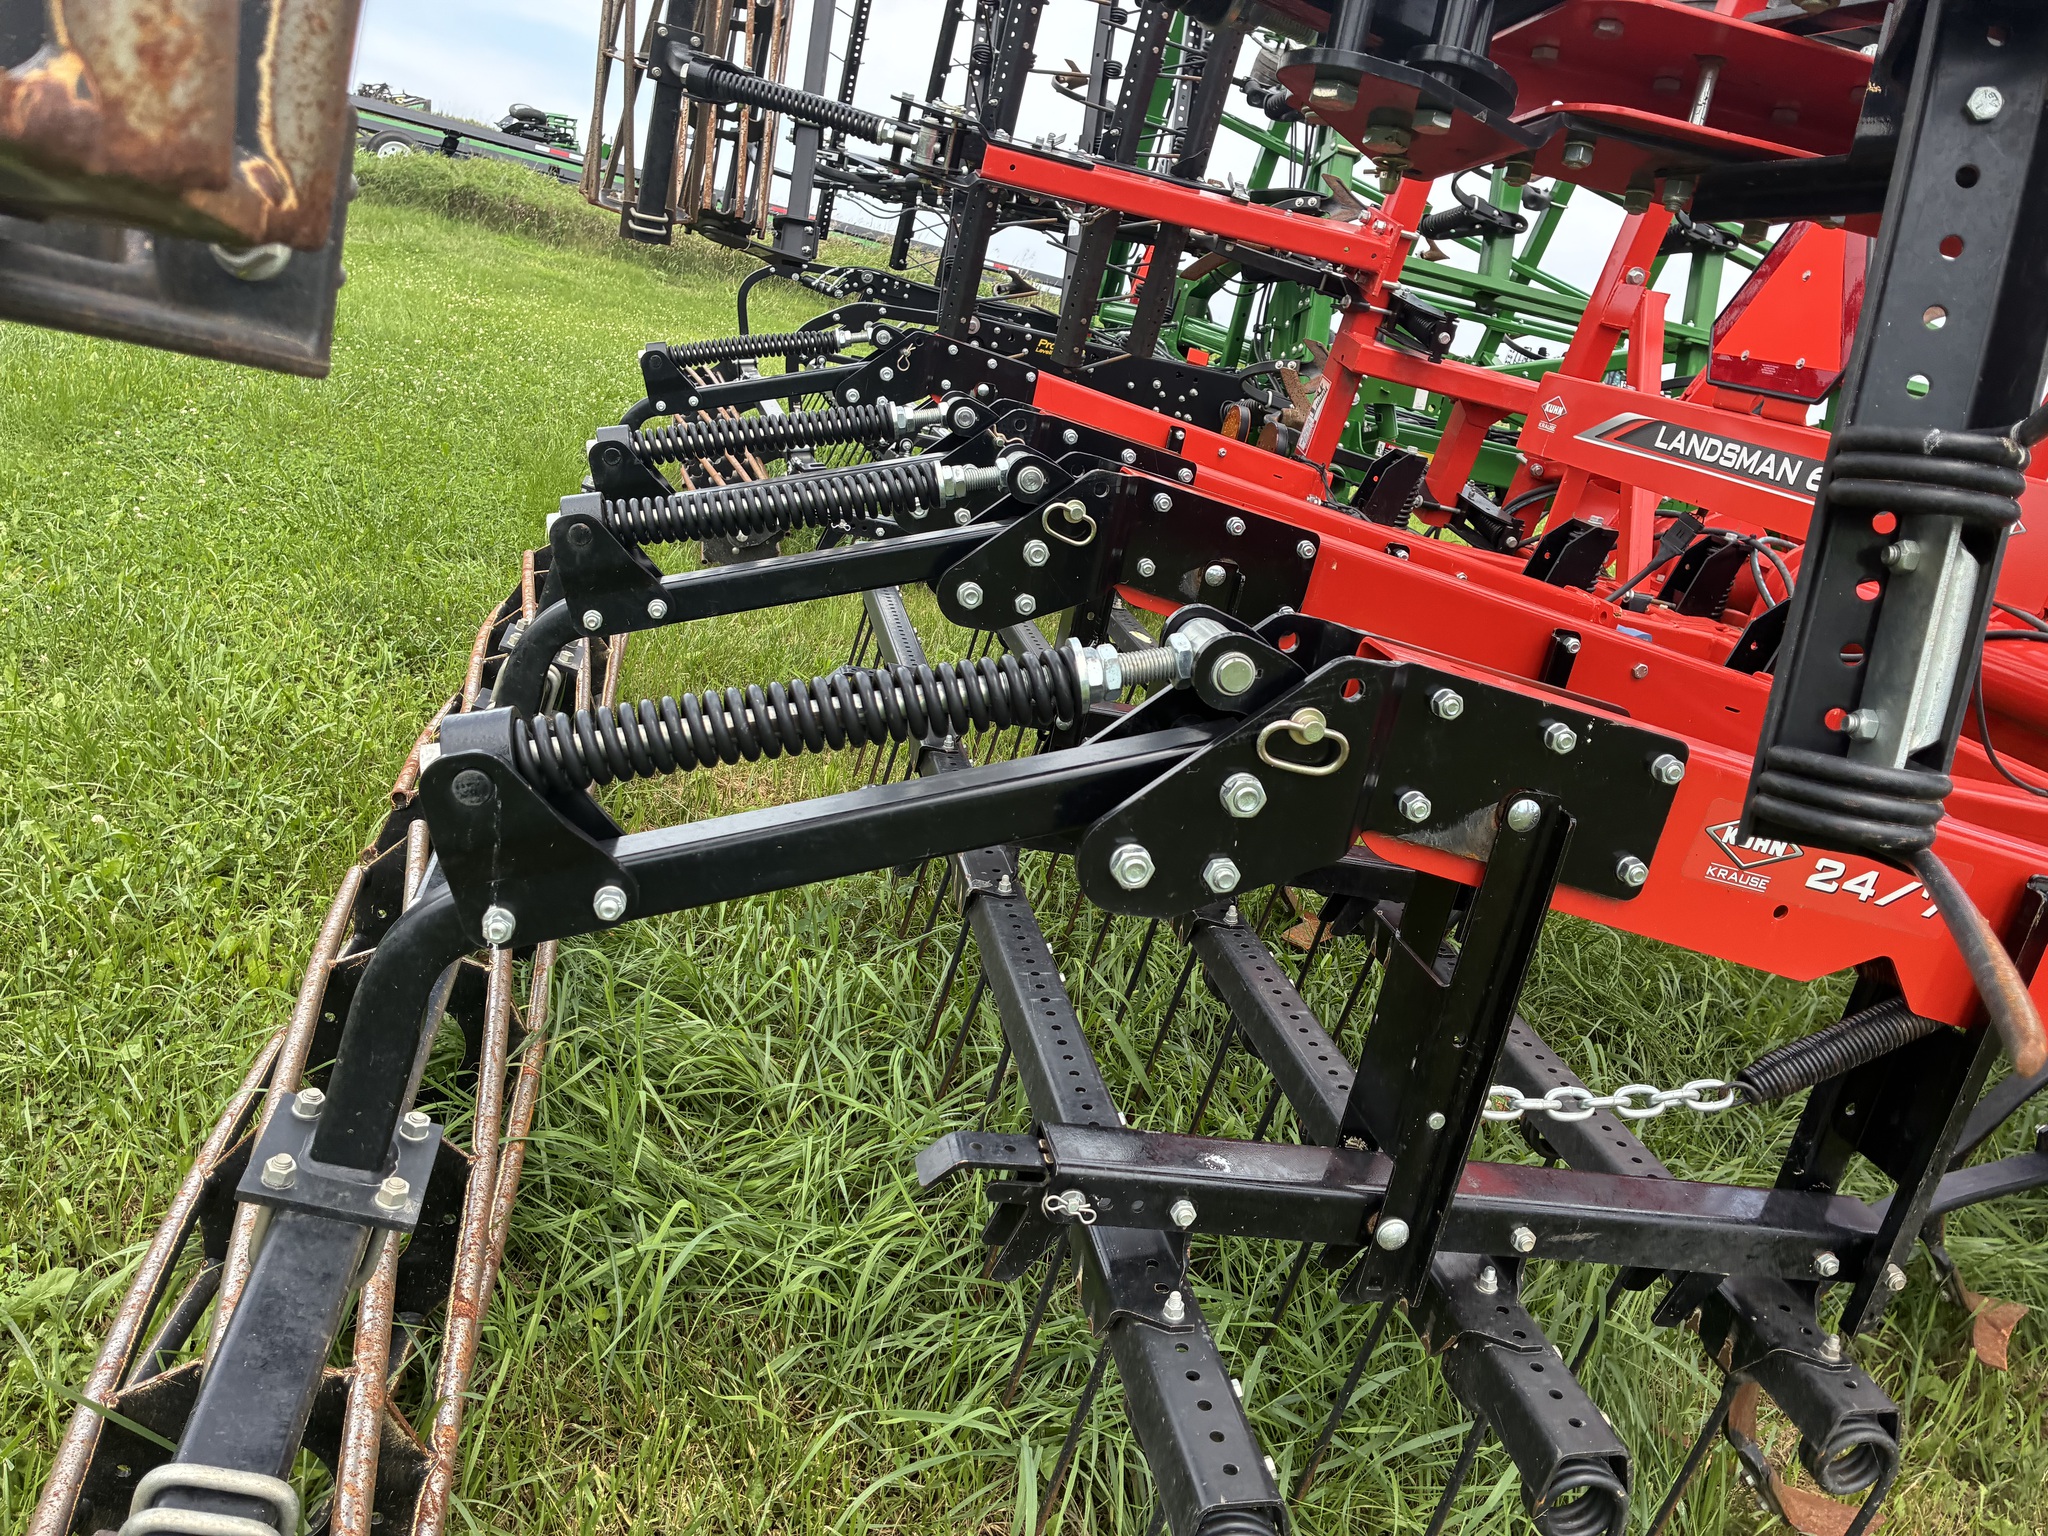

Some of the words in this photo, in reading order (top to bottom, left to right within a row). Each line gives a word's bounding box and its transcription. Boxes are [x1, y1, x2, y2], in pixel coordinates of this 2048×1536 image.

[1544, 403, 1565, 417] KUHN
[1653, 425, 1803, 487] LANDSMAN
[1804, 466, 1825, 493] 6
[1705, 865, 1771, 891] KRAUSE
[1804, 857, 1939, 919] 24/
